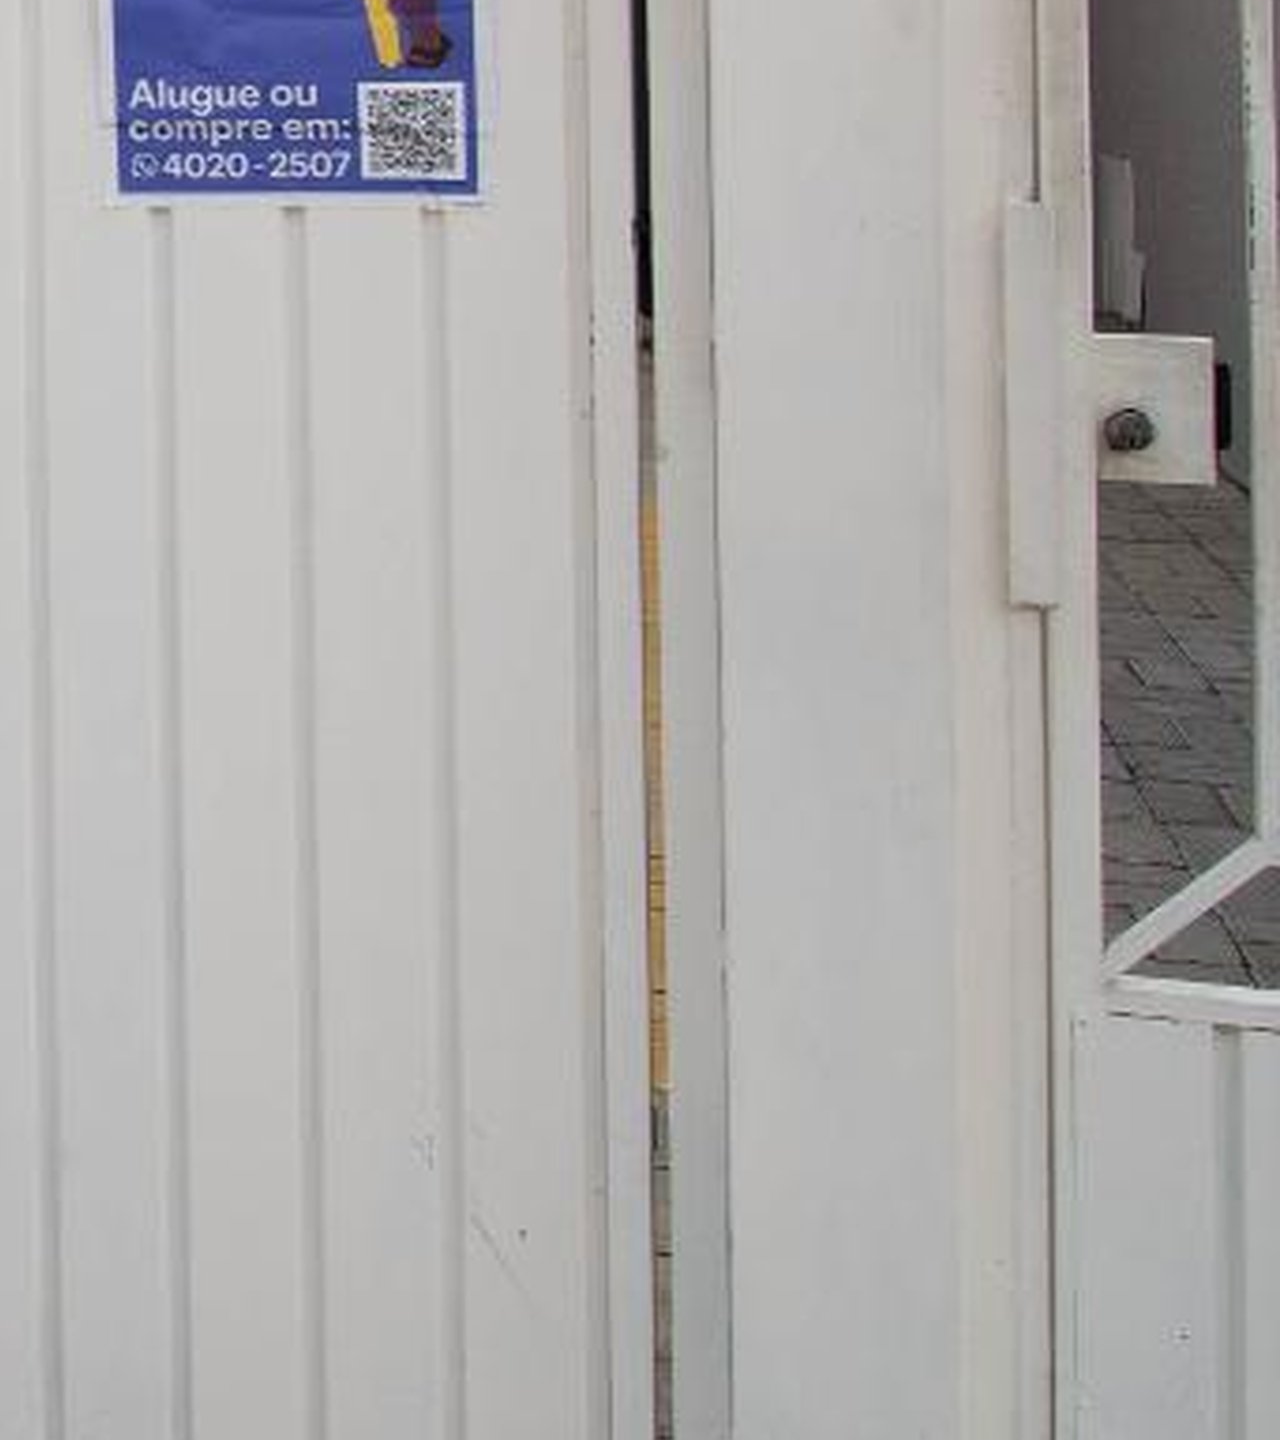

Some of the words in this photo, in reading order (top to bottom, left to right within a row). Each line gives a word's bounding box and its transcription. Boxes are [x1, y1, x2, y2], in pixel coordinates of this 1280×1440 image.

[129, 78, 261, 117] Alugue
[269, 84, 319, 108] ou
[129, 118, 274, 148] compre
[282, 119, 353, 142] em:
